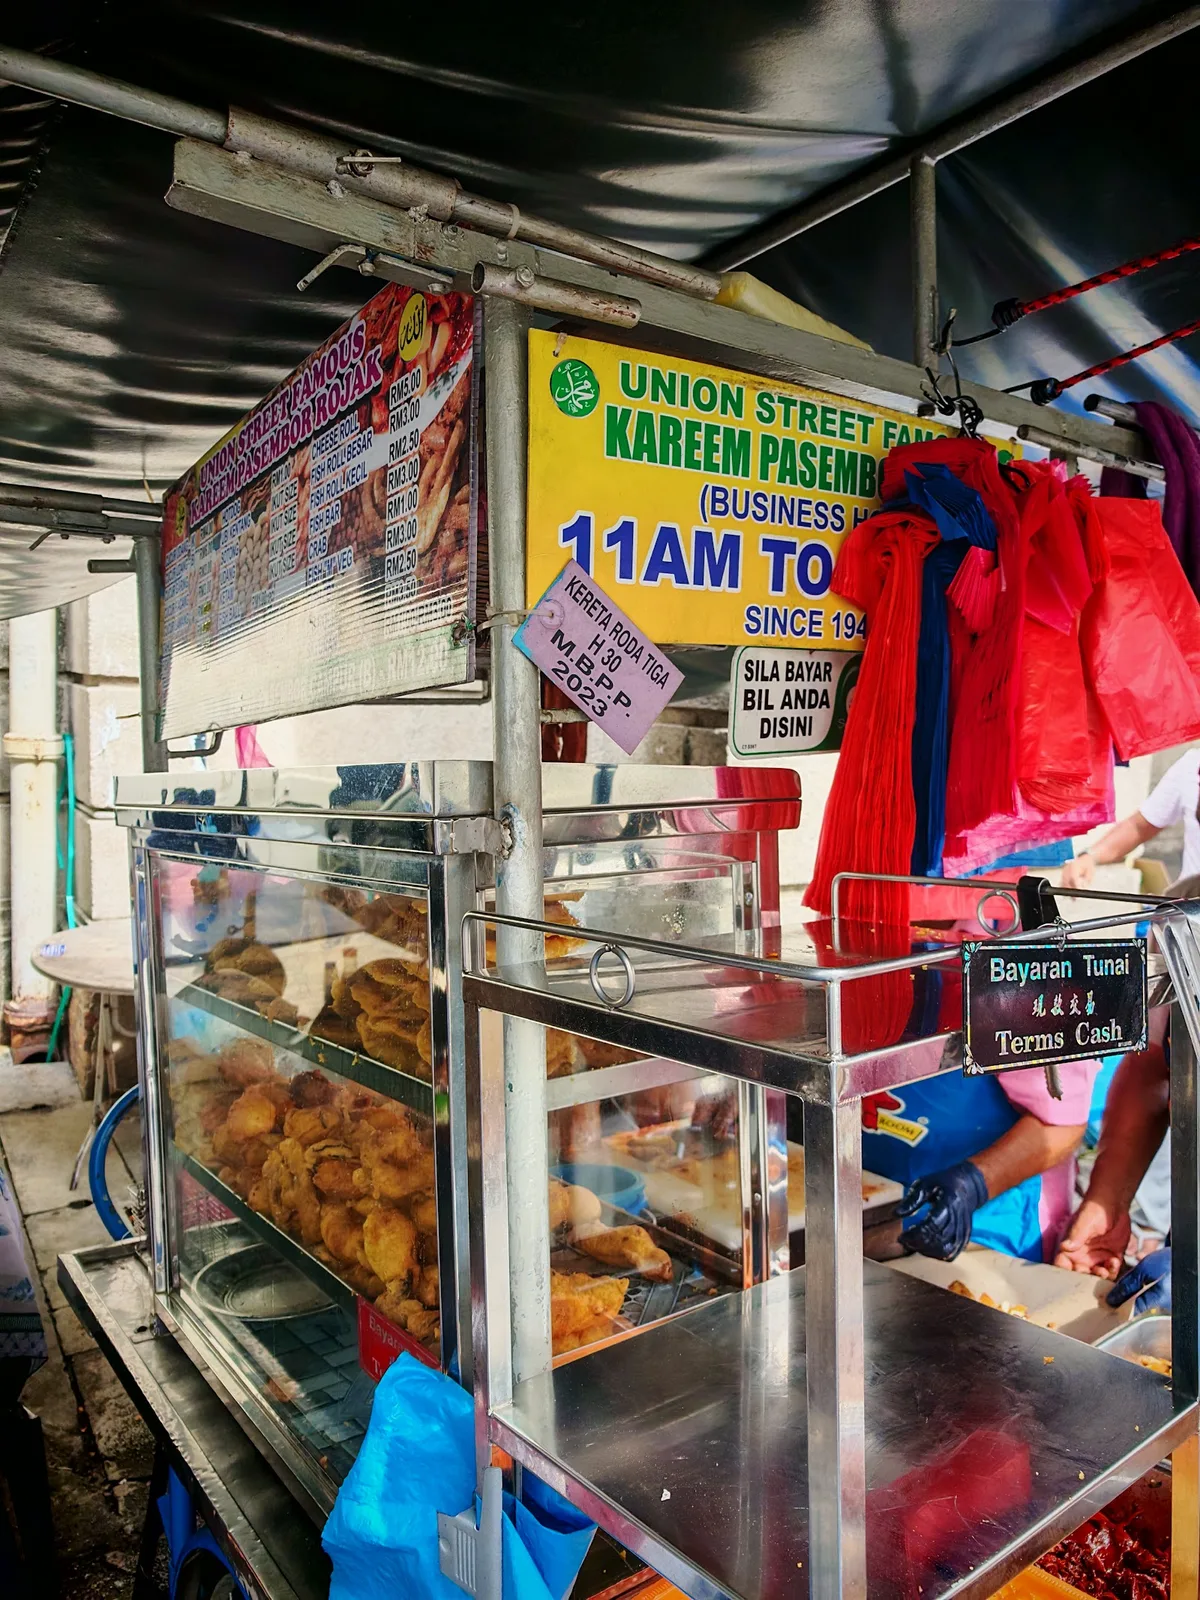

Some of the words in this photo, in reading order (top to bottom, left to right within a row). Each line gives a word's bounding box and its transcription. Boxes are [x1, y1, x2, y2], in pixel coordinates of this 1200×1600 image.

[390, 368, 421, 406] RM5.00
[201, 437, 236, 488] UNION
[238, 390, 289, 456] STREET
[292, 323, 364, 411] FAMOUS
[389, 400, 420, 434] RM3.00
[620, 362, 744, 419] UNION
[756, 391, 875, 445] STREET
[882, 420, 947, 448] FAM
[190, 467, 236, 525] KAREEM
[236, 406, 312, 489] PASEMBOR
[315, 348, 381, 427] ROJAK
[312, 427, 338, 460] CHEESE
[340, 413, 359, 441] ROLL
[388, 429, 419, 464] RM2.50
[605, 405, 752, 478] KAREEM
[759, 433, 884, 498] PASEMB
[311, 461, 326, 483] FISH
[327, 449, 345, 473] ROLL
[347, 430, 373, 462] BESAR
[285, 483, 297, 502] SIZE
[311, 485, 325, 508] FISH
[326, 475, 344, 500] ROLL
[346, 461, 368, 488] KECIL
[388, 458, 419, 492] RM3.00
[284, 507, 296, 526] SIZE
[309, 513, 324, 536] FISH
[326, 503, 341, 526] BAR
[387, 488, 417, 518] RM1.00
[700, 484, 845, 531] (BUSINESS
[853, 506, 880, 529] H
[308, 535, 327, 560] CRAB
[386, 519, 417, 549] RM3.00
[337, 549, 352, 572] VEG
[386, 549, 416, 578] RM2.50
[562, 514, 741, 589] 11AM
[761, 537, 832, 596] TO
[564, 575, 613, 631] KERETA
[609, 621, 644, 664] RODA
[641, 653, 670, 689] TIGA
[744, 606, 823, 638] SINCE
[587, 634, 606, 656] H
[601, 648, 622, 673] 30
[744, 659, 780, 682] SILA
[785, 661, 833, 682] BAYAR
[550, 629, 632, 718] M.B.P.P.
[551, 660, 608, 717] 2023
[743, 688, 774, 711] BIL
[780, 689, 830, 710] ANDA
[760, 715, 813, 739] DISINI
[990, 957, 1072, 987] Bayaran
[1083, 953, 1129, 977] Tunai
[995, 1029, 1064, 1056] Terms
[1075, 1019, 1123, 1047] Cash
